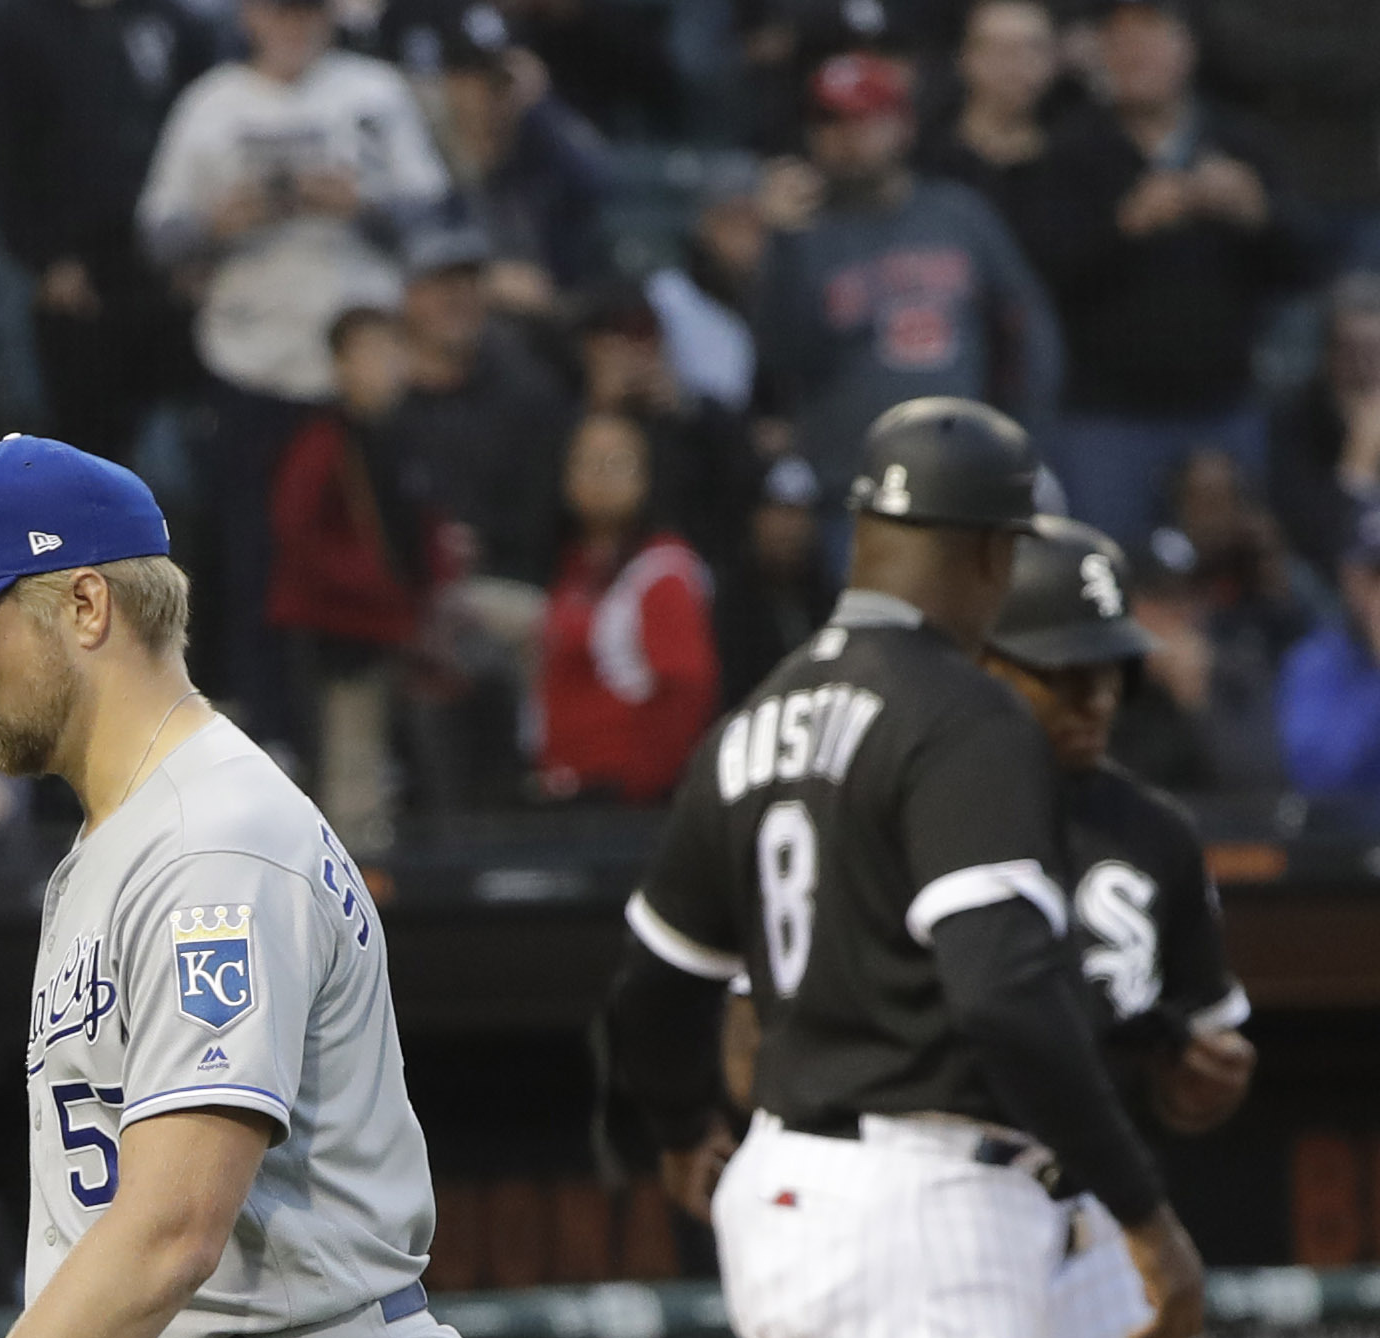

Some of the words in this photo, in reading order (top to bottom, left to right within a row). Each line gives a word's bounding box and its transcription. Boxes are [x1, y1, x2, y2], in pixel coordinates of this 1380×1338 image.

[756, 799, 819, 999] 8
[179, 949, 248, 1008] KC
[50, 1079, 125, 1213] 5
